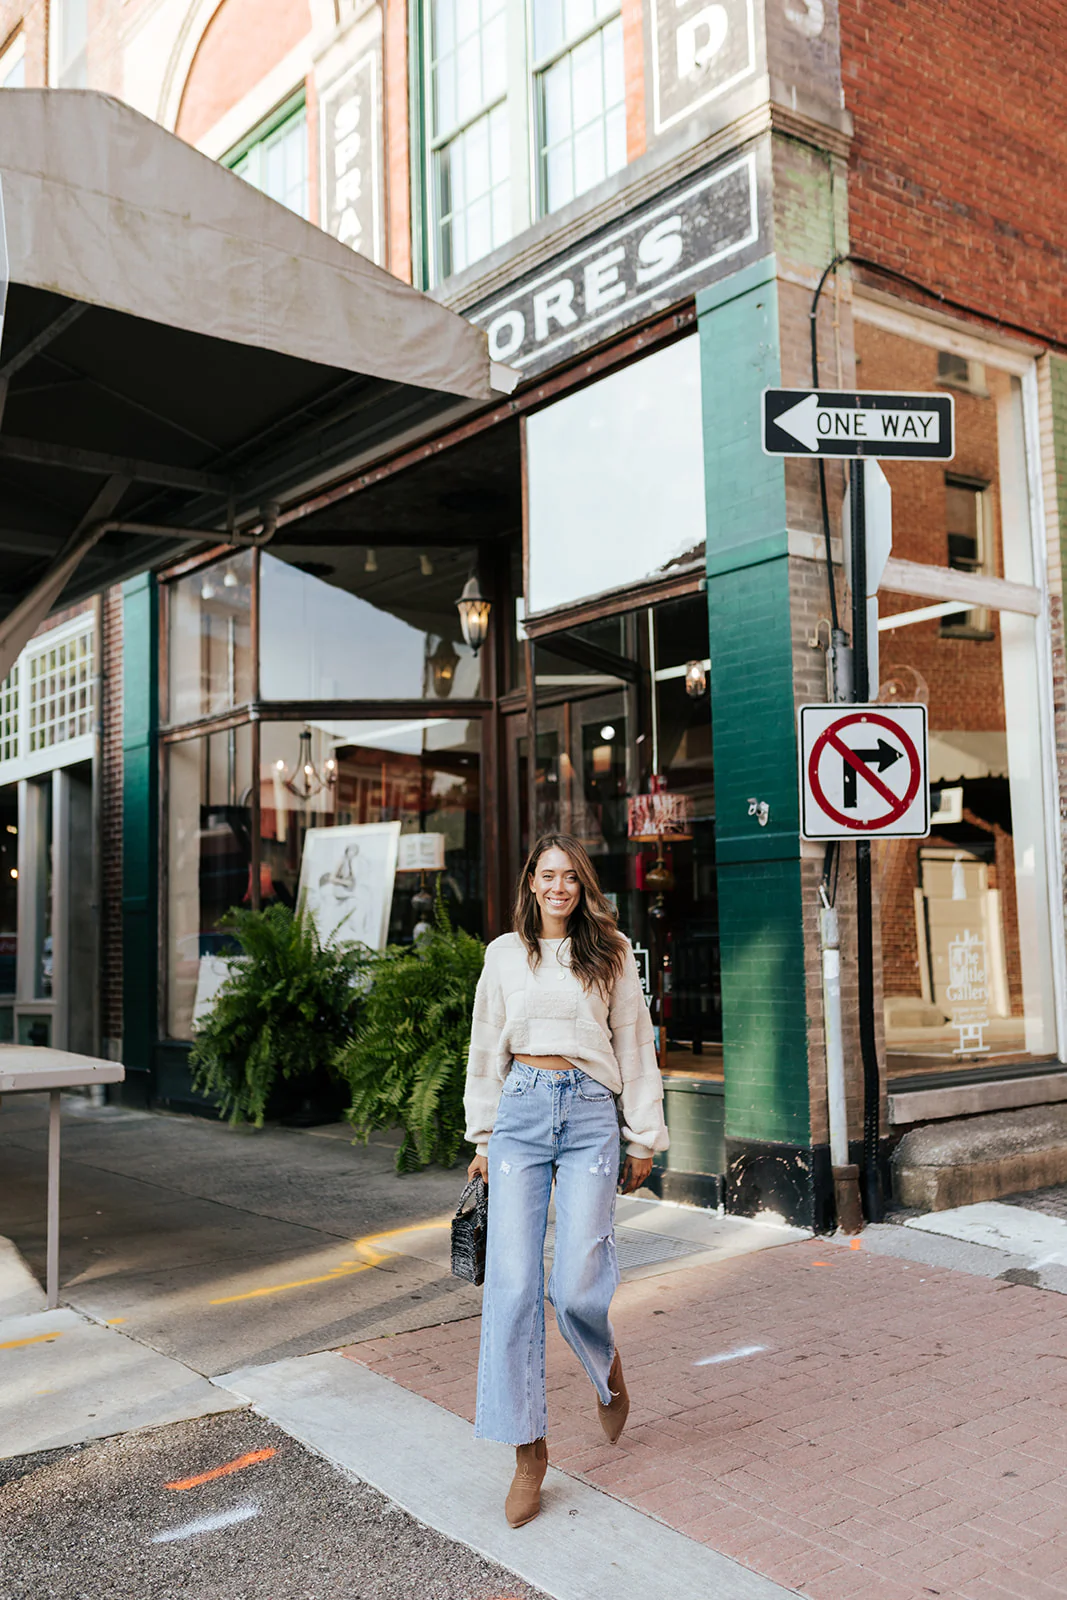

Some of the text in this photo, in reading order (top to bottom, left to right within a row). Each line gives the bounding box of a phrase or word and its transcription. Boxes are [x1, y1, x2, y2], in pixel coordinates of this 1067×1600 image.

[335, 95, 361, 252] SPRA
[487, 215, 683, 362] ORES
[817, 412, 933, 438] ONE WAY
[946, 984, 989, 1005] Gallery
